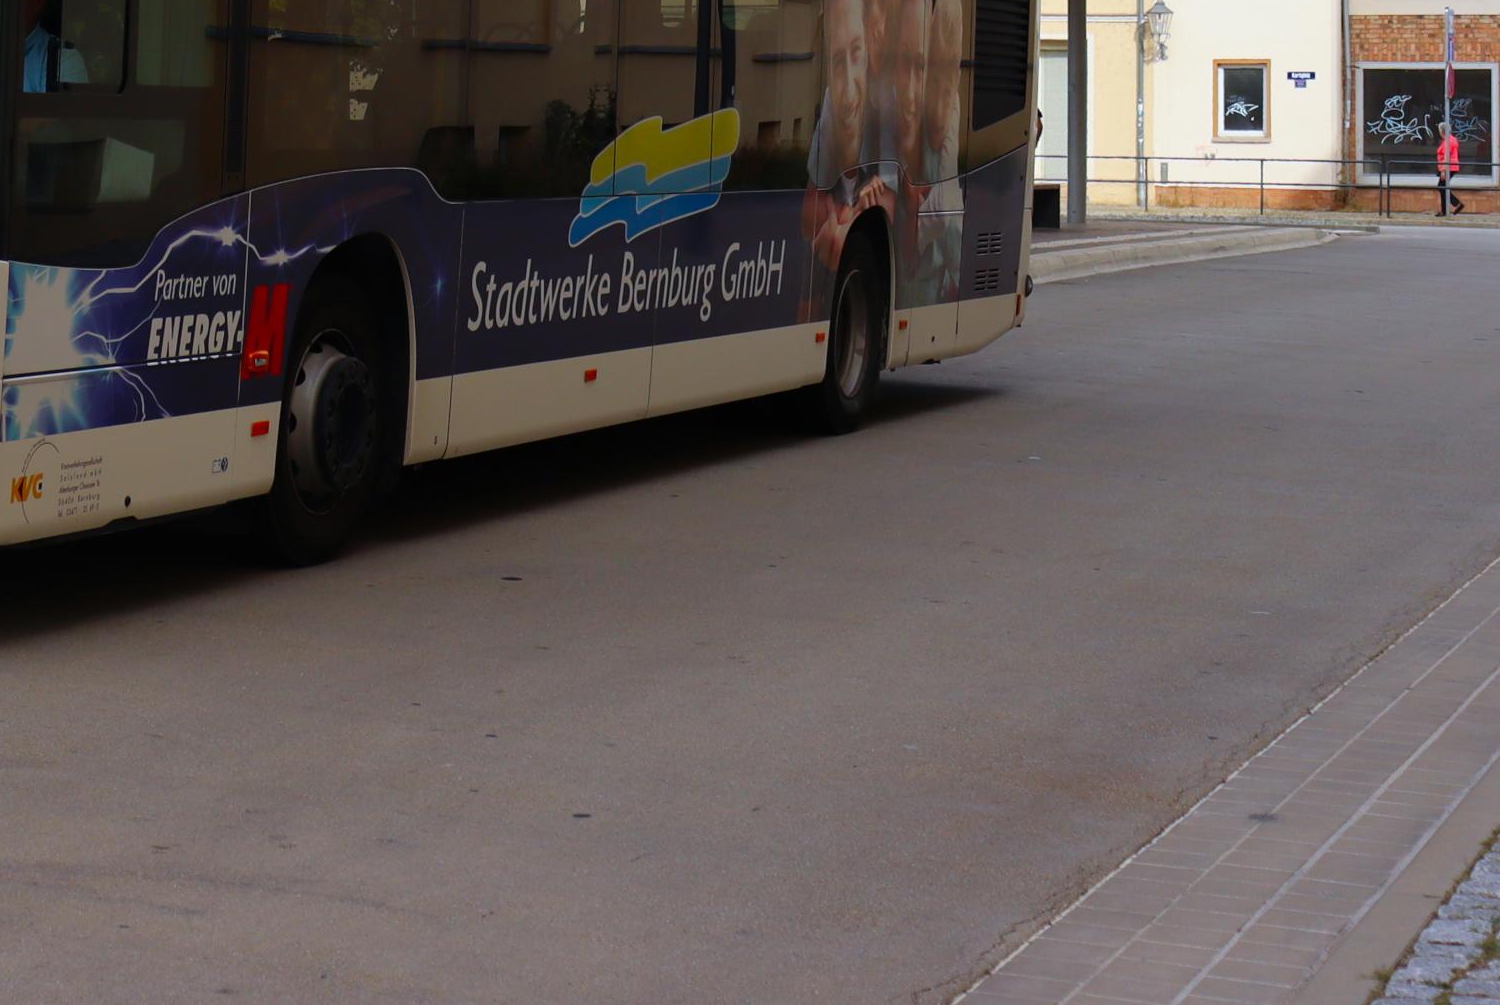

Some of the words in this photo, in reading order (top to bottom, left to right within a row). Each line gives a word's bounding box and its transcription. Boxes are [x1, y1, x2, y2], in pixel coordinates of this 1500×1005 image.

[154, 269, 209, 302] Partner
[212, 273, 237, 296] von
[467, 254, 611, 332] Stadtwerke
[617, 248, 716, 323] Bernburg
[721, 239, 786, 302] GmbH
